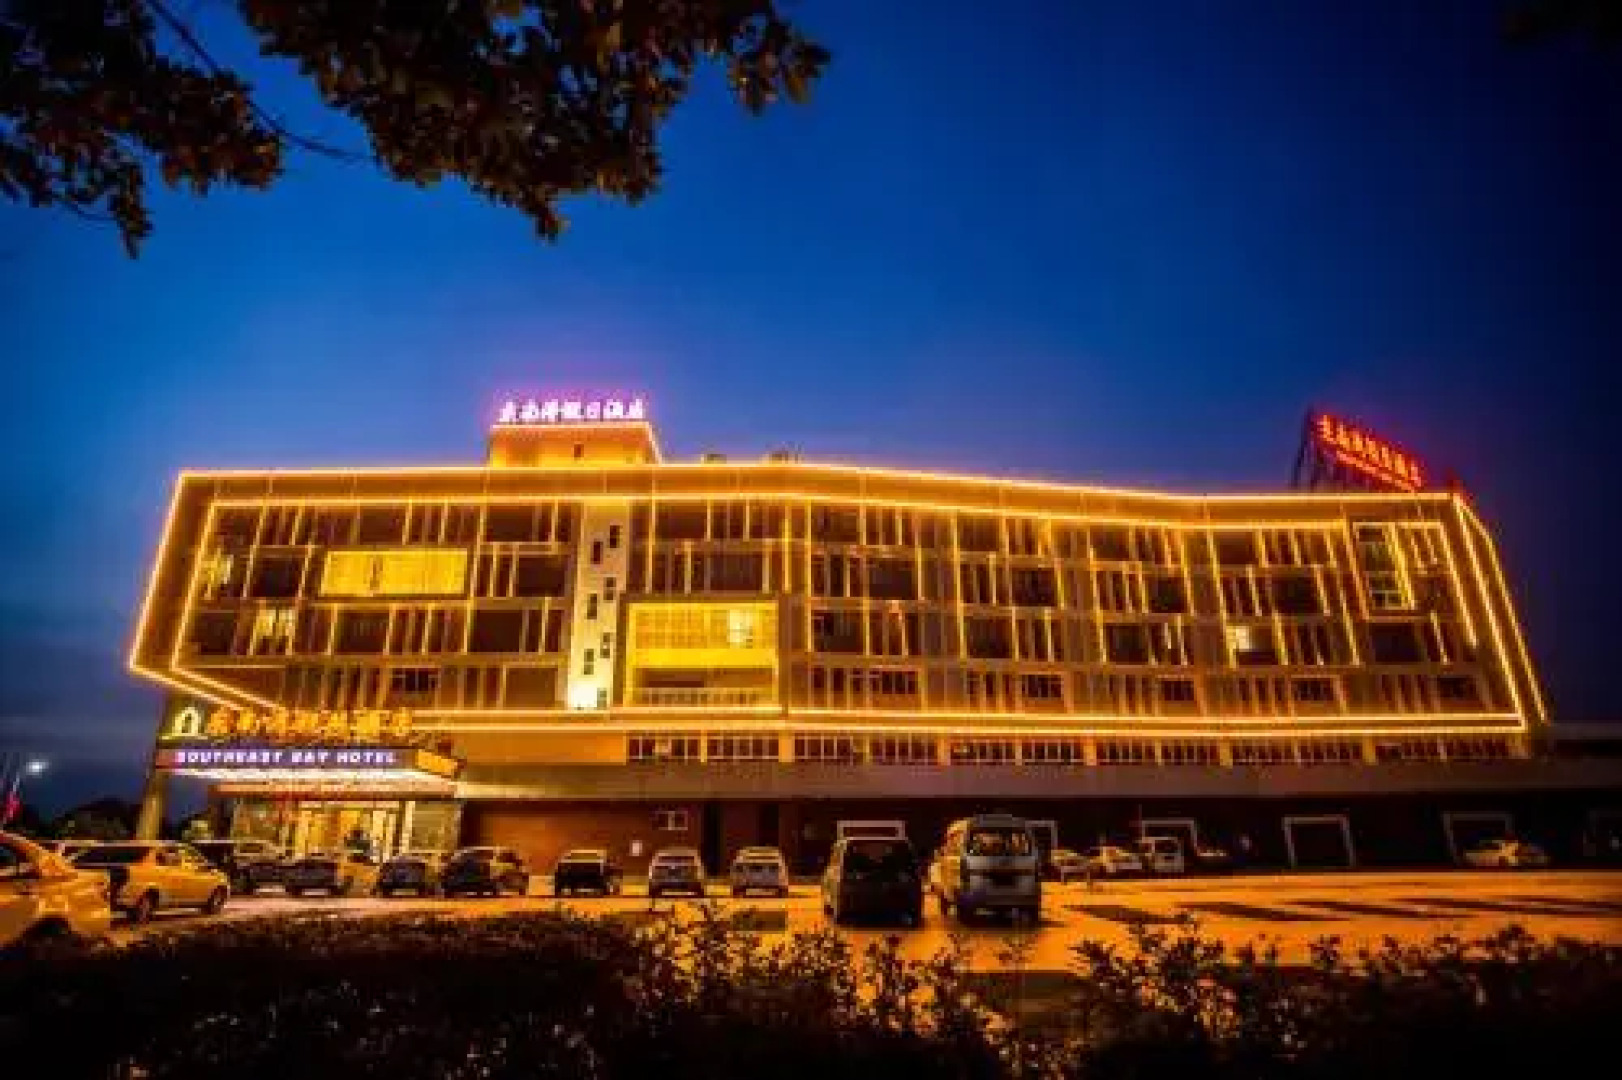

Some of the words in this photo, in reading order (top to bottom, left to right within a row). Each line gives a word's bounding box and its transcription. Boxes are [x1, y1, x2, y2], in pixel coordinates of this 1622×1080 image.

[175, 750, 283, 764] SOUTHEAST
[291, 750, 331, 764] BAY
[336, 750, 396, 764] HOTEL
